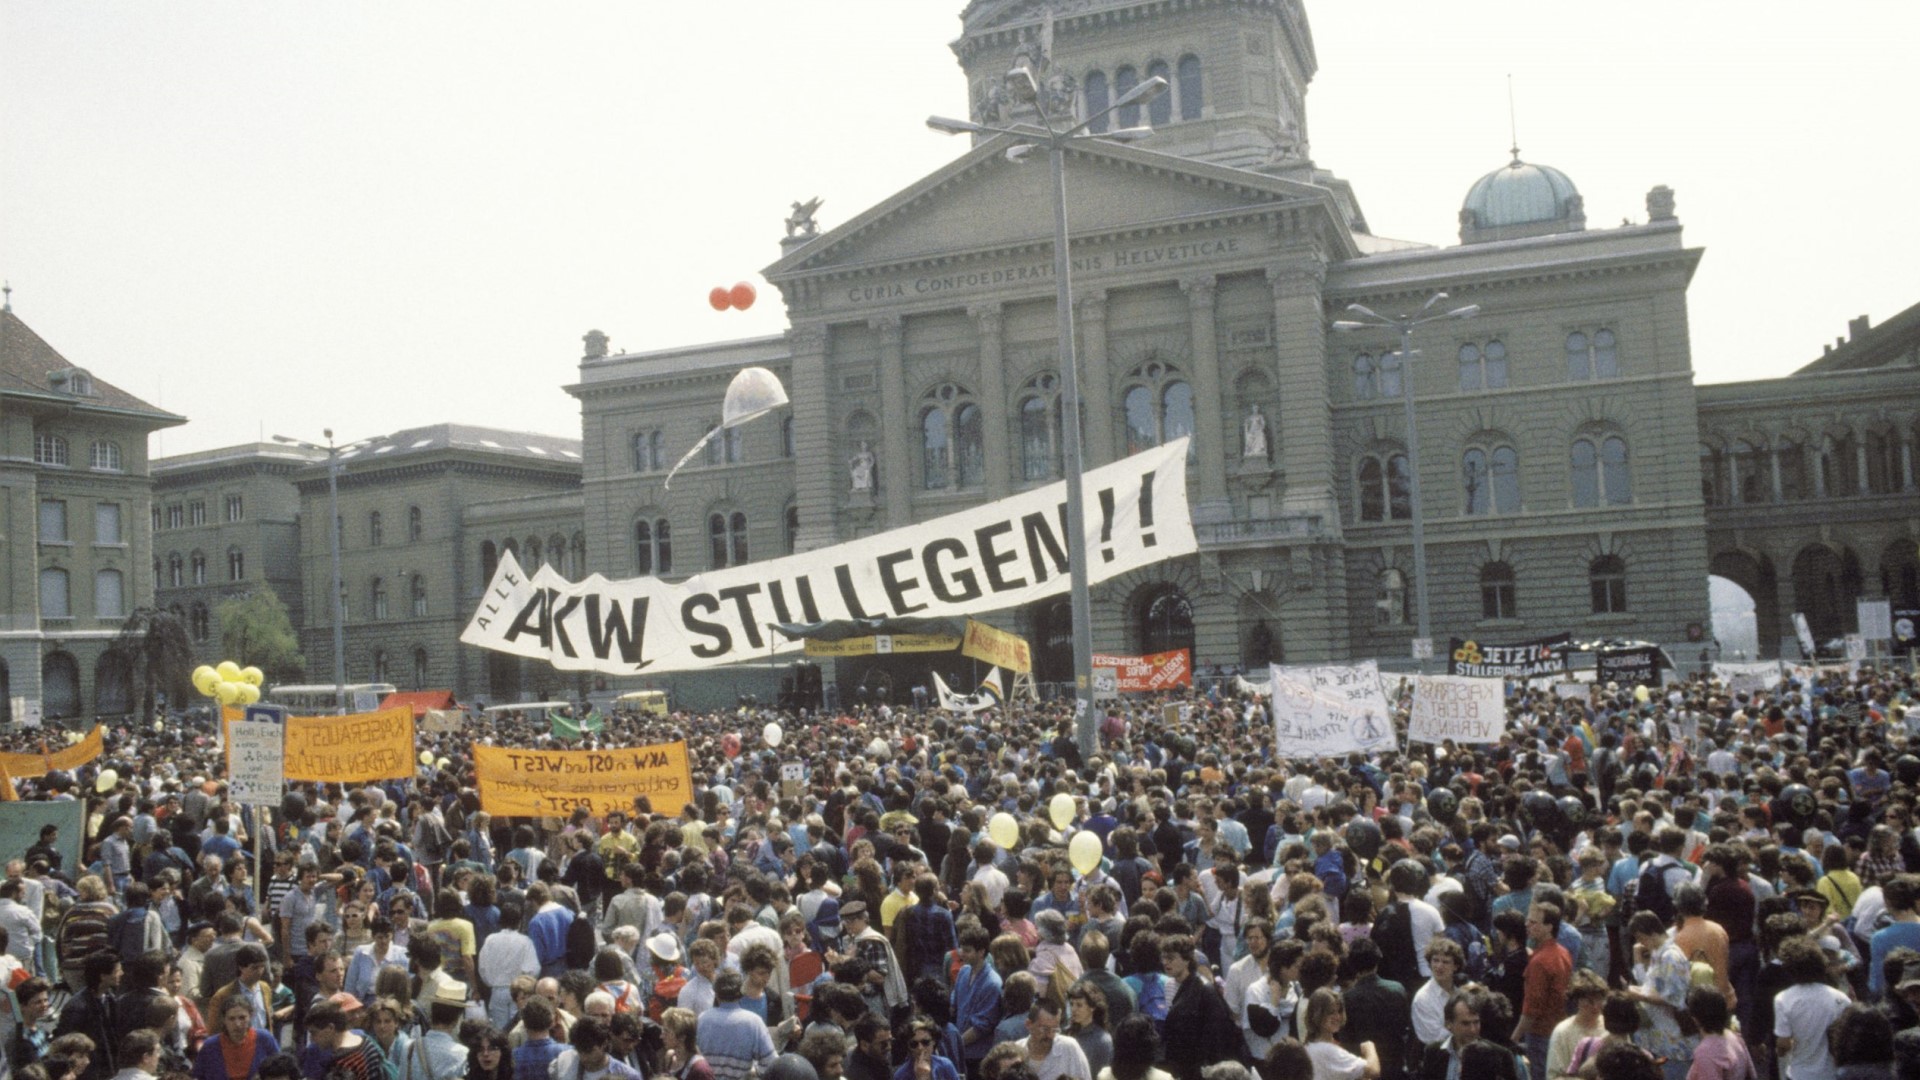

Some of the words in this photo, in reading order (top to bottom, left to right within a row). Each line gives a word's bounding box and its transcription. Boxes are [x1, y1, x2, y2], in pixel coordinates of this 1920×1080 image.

[848, 285, 904, 302] CURIA
[915, 256, 1103, 293] CONFOEDERATINIS
[1114, 239, 1239, 266] HELVETICAE
[477, 571, 520, 632] ALLE
[503, 587, 650, 664] AKW
